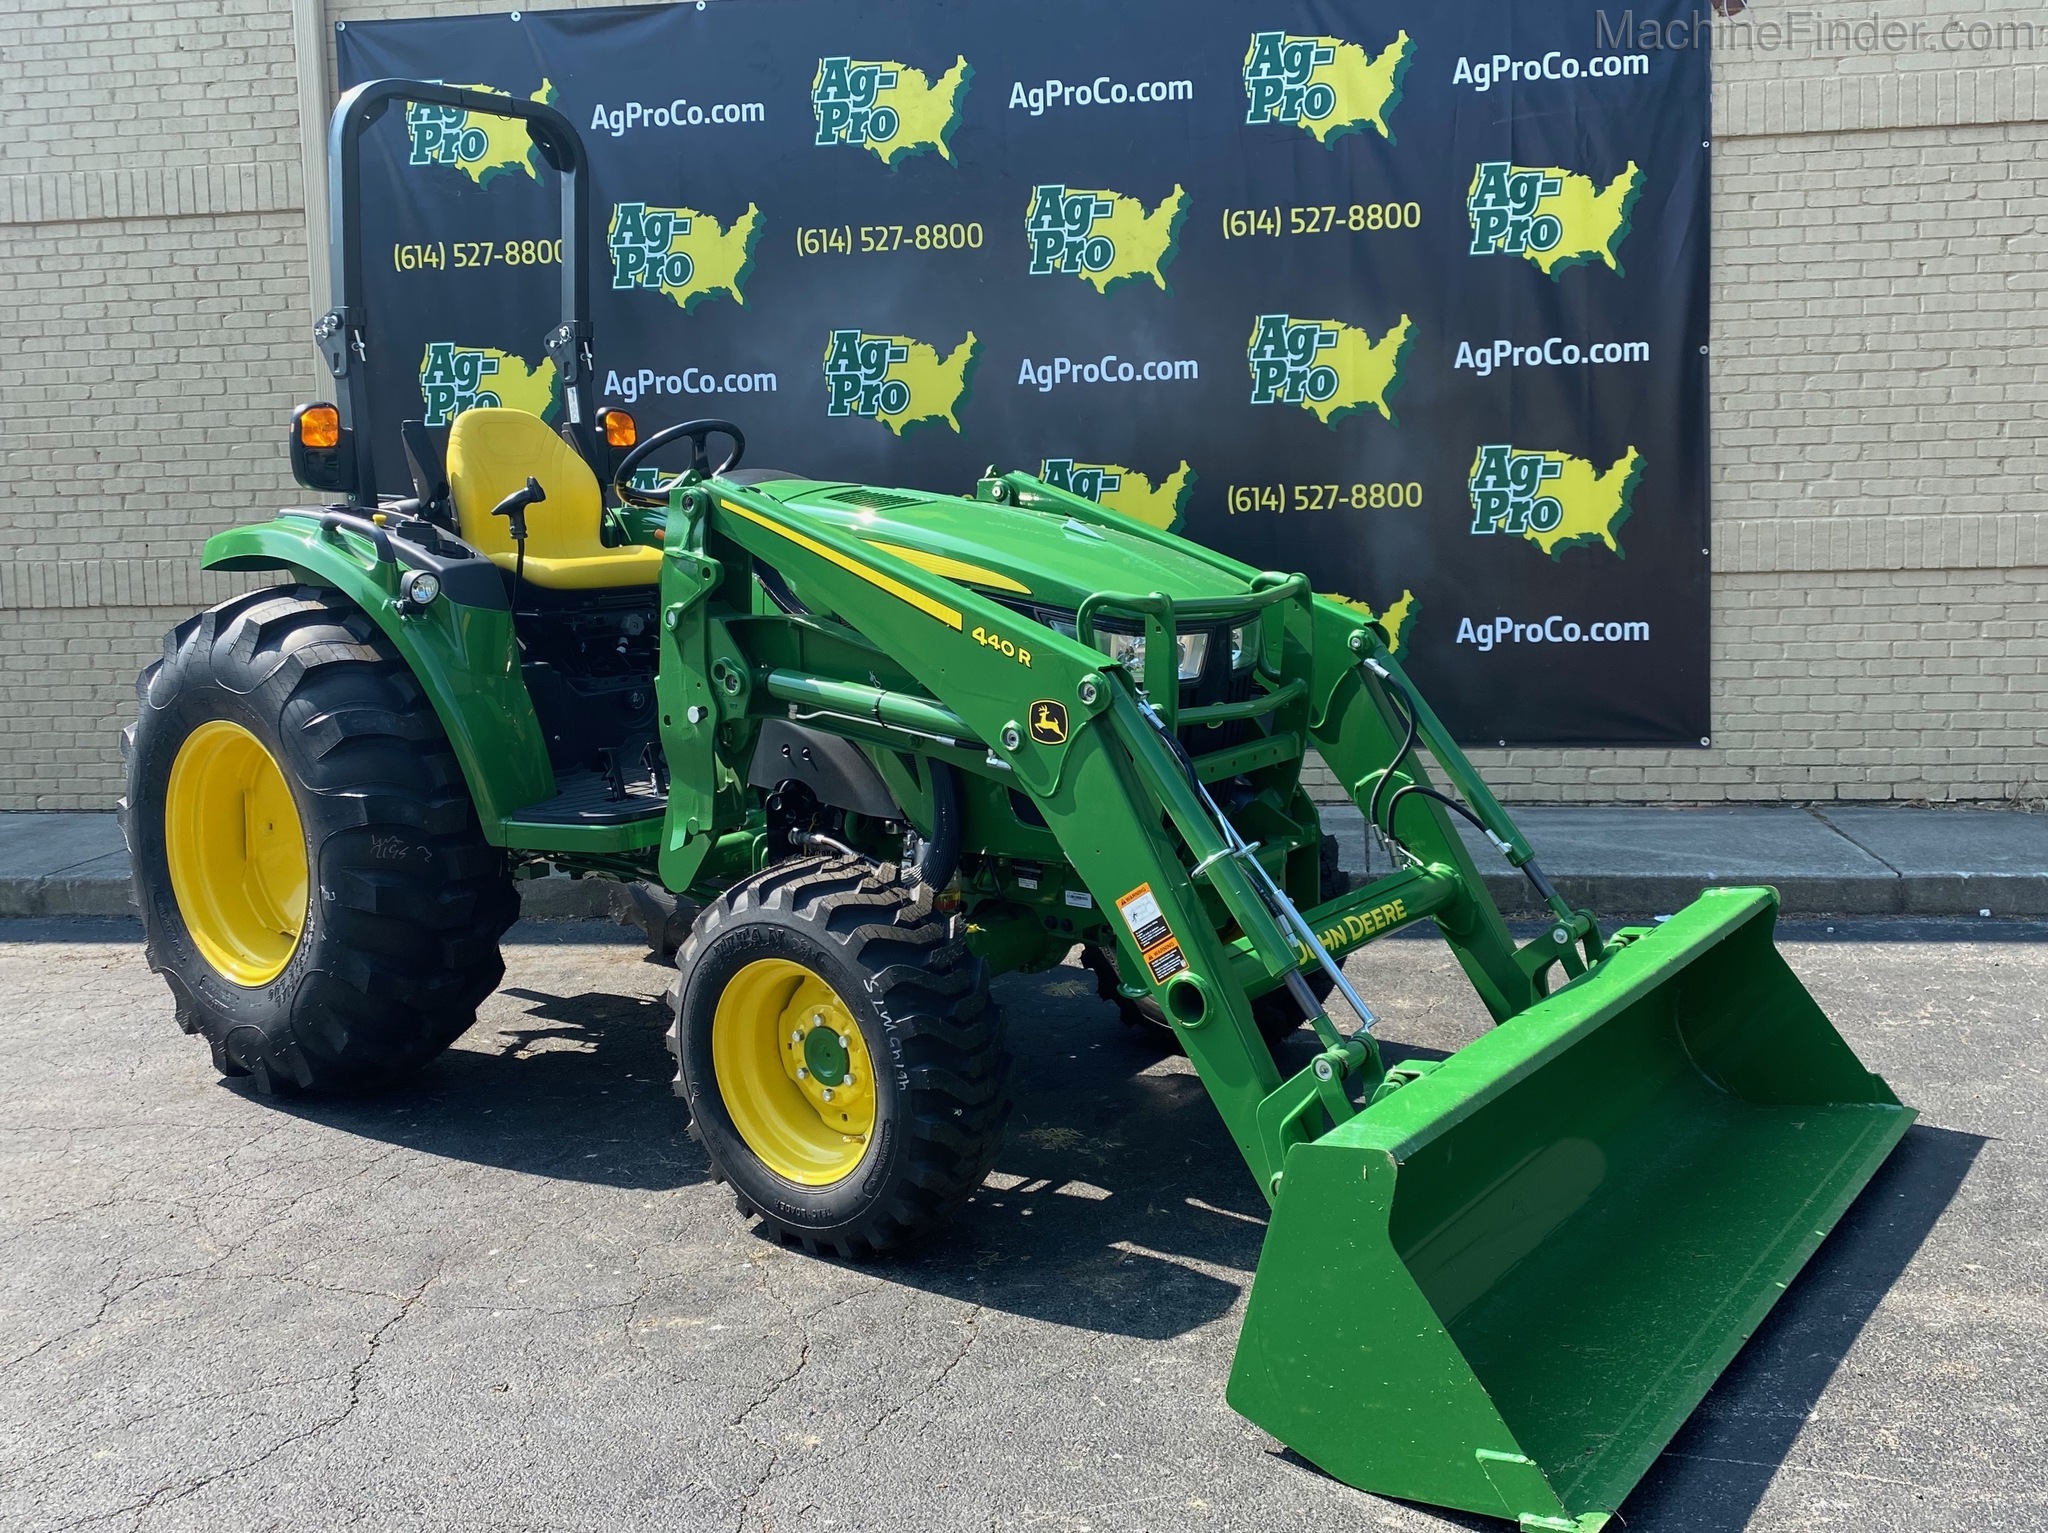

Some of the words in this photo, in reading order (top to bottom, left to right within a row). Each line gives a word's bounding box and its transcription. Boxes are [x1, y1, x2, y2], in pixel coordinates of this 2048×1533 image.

[1248, 31, 1334, 86] Ag-
[1453, 52, 1648, 91] AgProCo.com
[815, 56, 897, 107] Ag-
[1009, 77, 1192, 115] AgProCo.com
[1245, 79, 1335, 125] Pro
[591, 100, 764, 136] AgProCo.com
[815, 100, 899, 147] Pro
[409, 122, 488, 166] Pro
[1029, 184, 1113, 238] Ag-
[1471, 162, 1562, 217] Ag-
[612, 202, 691, 253] Ag-
[796, 226, 851, 257] (614)
[860, 222, 983, 252] 527-8800
[1223, 206, 1281, 239] (614)
[1291, 202, 1421, 234] 527-8800
[1469, 209, 1563, 256] Pro
[394, 241, 445, 272] (614)
[611, 245, 694, 290] Pro
[1029, 230, 1114, 275] Pro
[828, 329, 908, 381] Ag-
[1253, 314, 1338, 369] Ag-
[1454, 338, 1649, 375] AgProCo.com
[422, 343, 499, 393] Ag-
[604, 368, 777, 403] AgProCo.com
[1018, 356, 1198, 392] AgProCo.com
[1250, 361, 1338, 404] Pro
[826, 373, 910, 417] Pro
[1472, 445, 1562, 499] Ag-
[1228, 484, 1285, 515] (614)
[1294, 482, 1423, 511] 527-8800
[1470, 491, 1563, 535] Pro
[1456, 615, 1650, 651] AgProCo.com
[1343, 898, 1407, 941] DEERE
